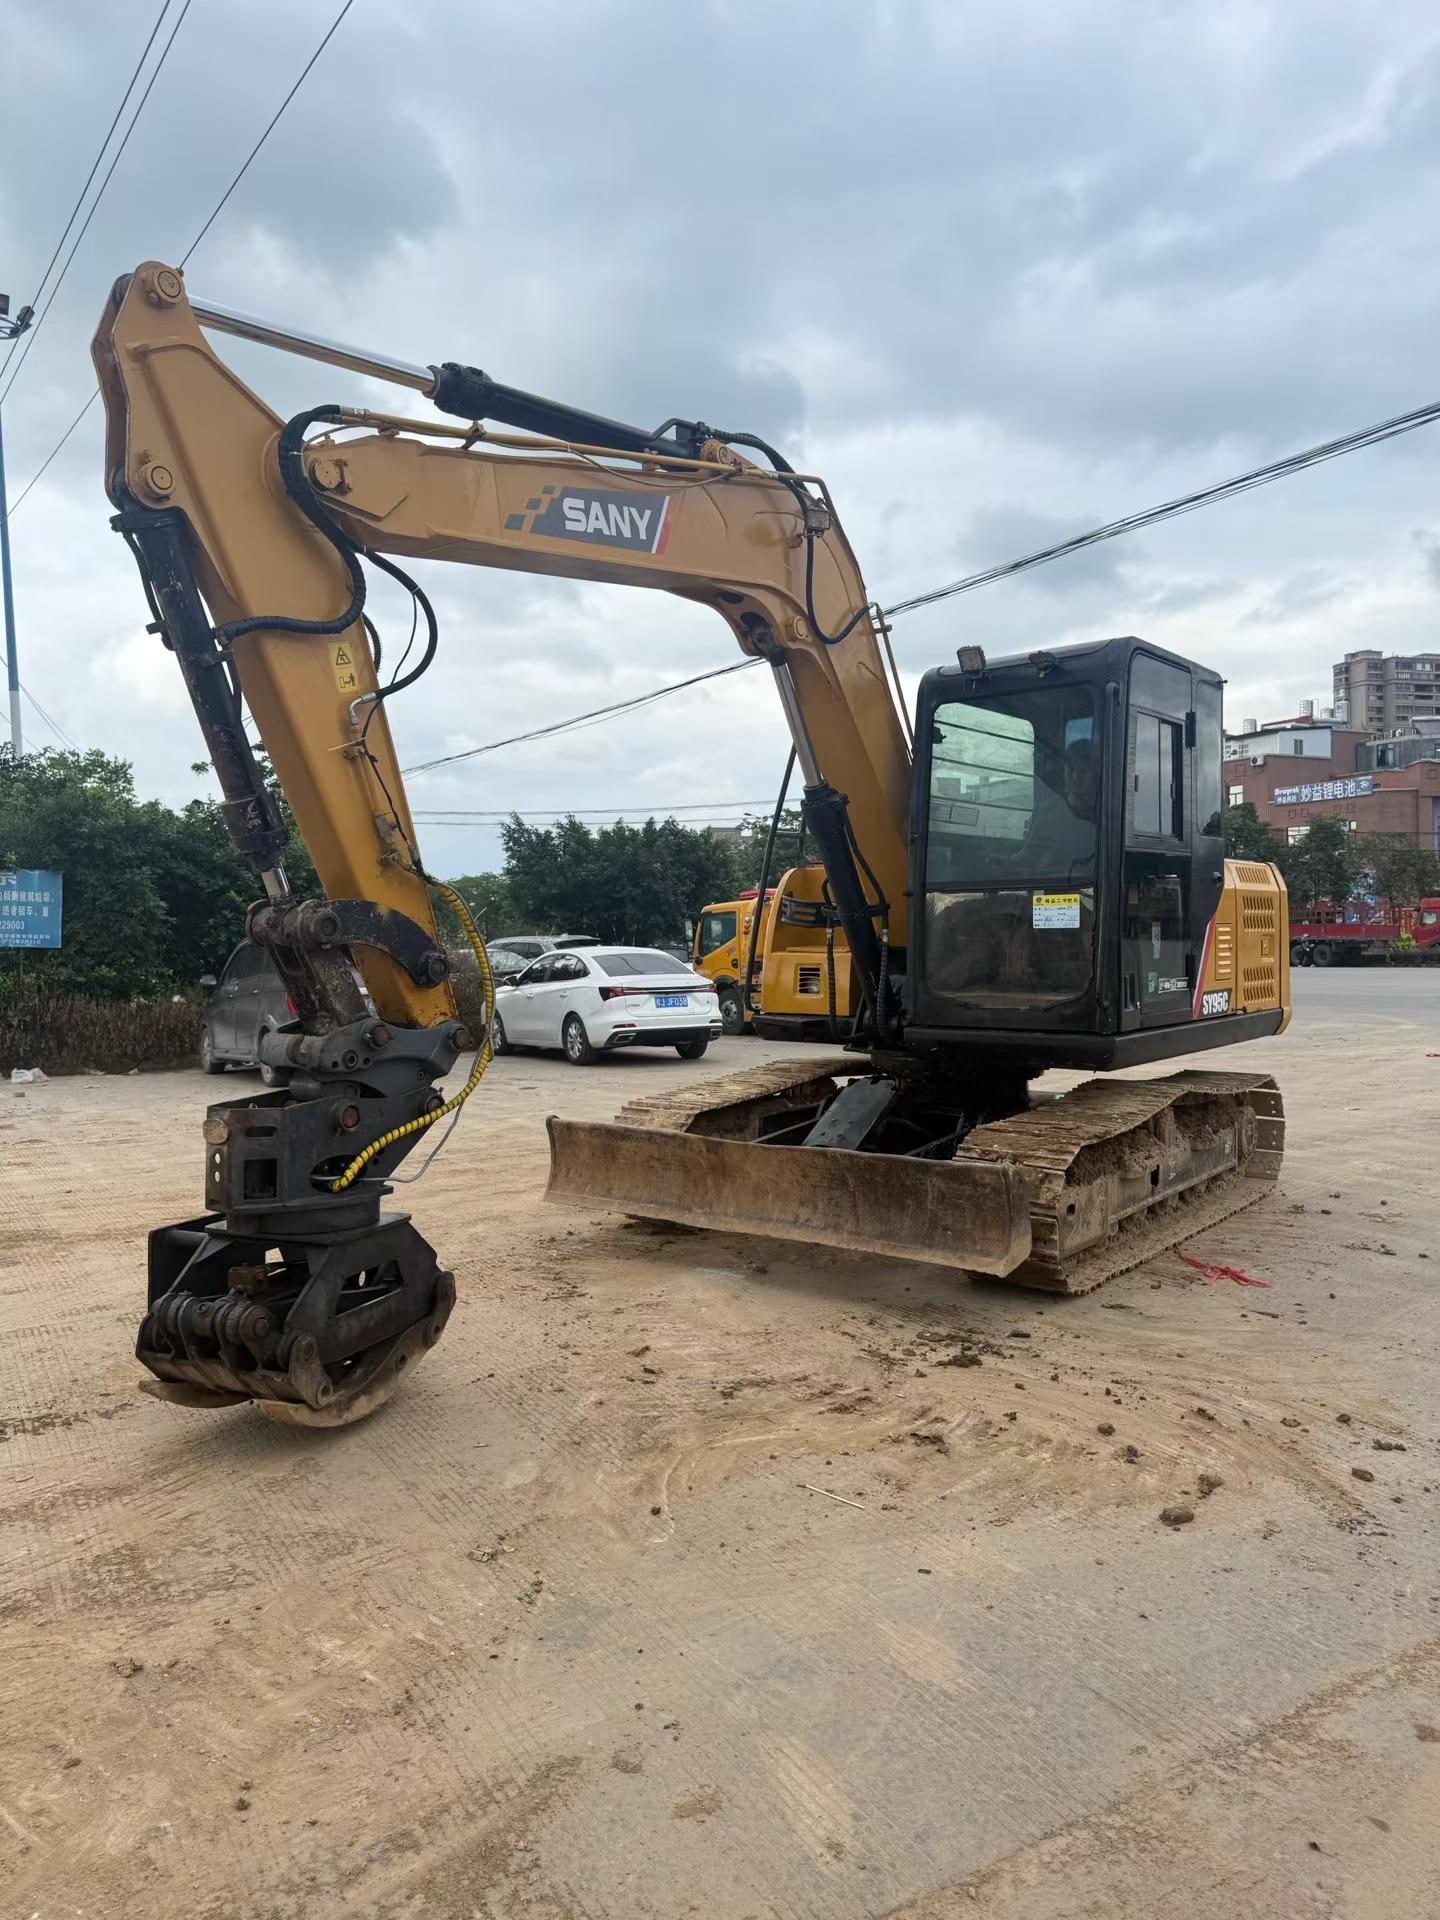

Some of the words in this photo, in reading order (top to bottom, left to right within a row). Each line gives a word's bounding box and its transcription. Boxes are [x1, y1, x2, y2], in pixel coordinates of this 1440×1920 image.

[562, 497, 652, 540] SANY
[1301, 779, 1356, 802] 妙益锂电池
[1202, 991, 1229, 1015] SY95C
